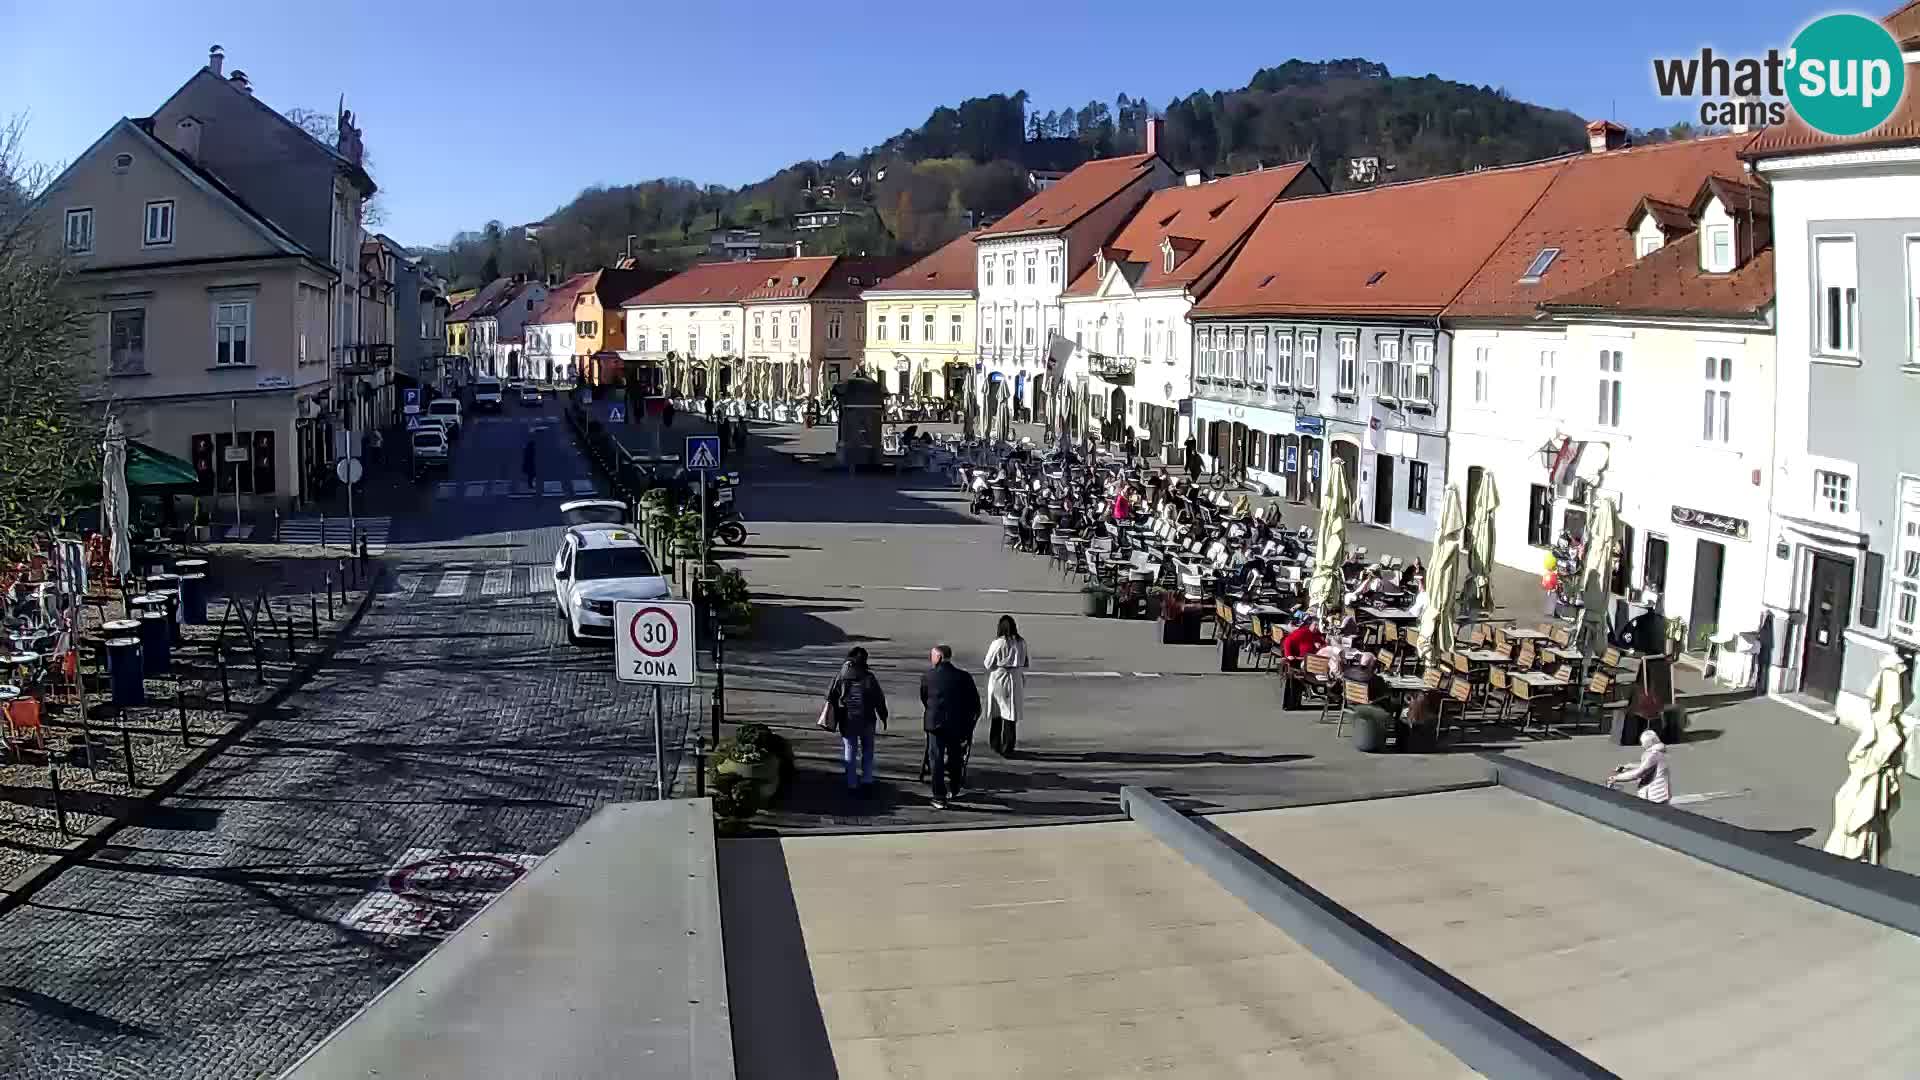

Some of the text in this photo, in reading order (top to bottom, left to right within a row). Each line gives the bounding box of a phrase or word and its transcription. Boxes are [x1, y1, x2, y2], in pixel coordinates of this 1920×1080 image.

[407, 391, 416, 403] P
[642, 622, 668, 644] 30
[633, 659, 678, 677] ZONA
